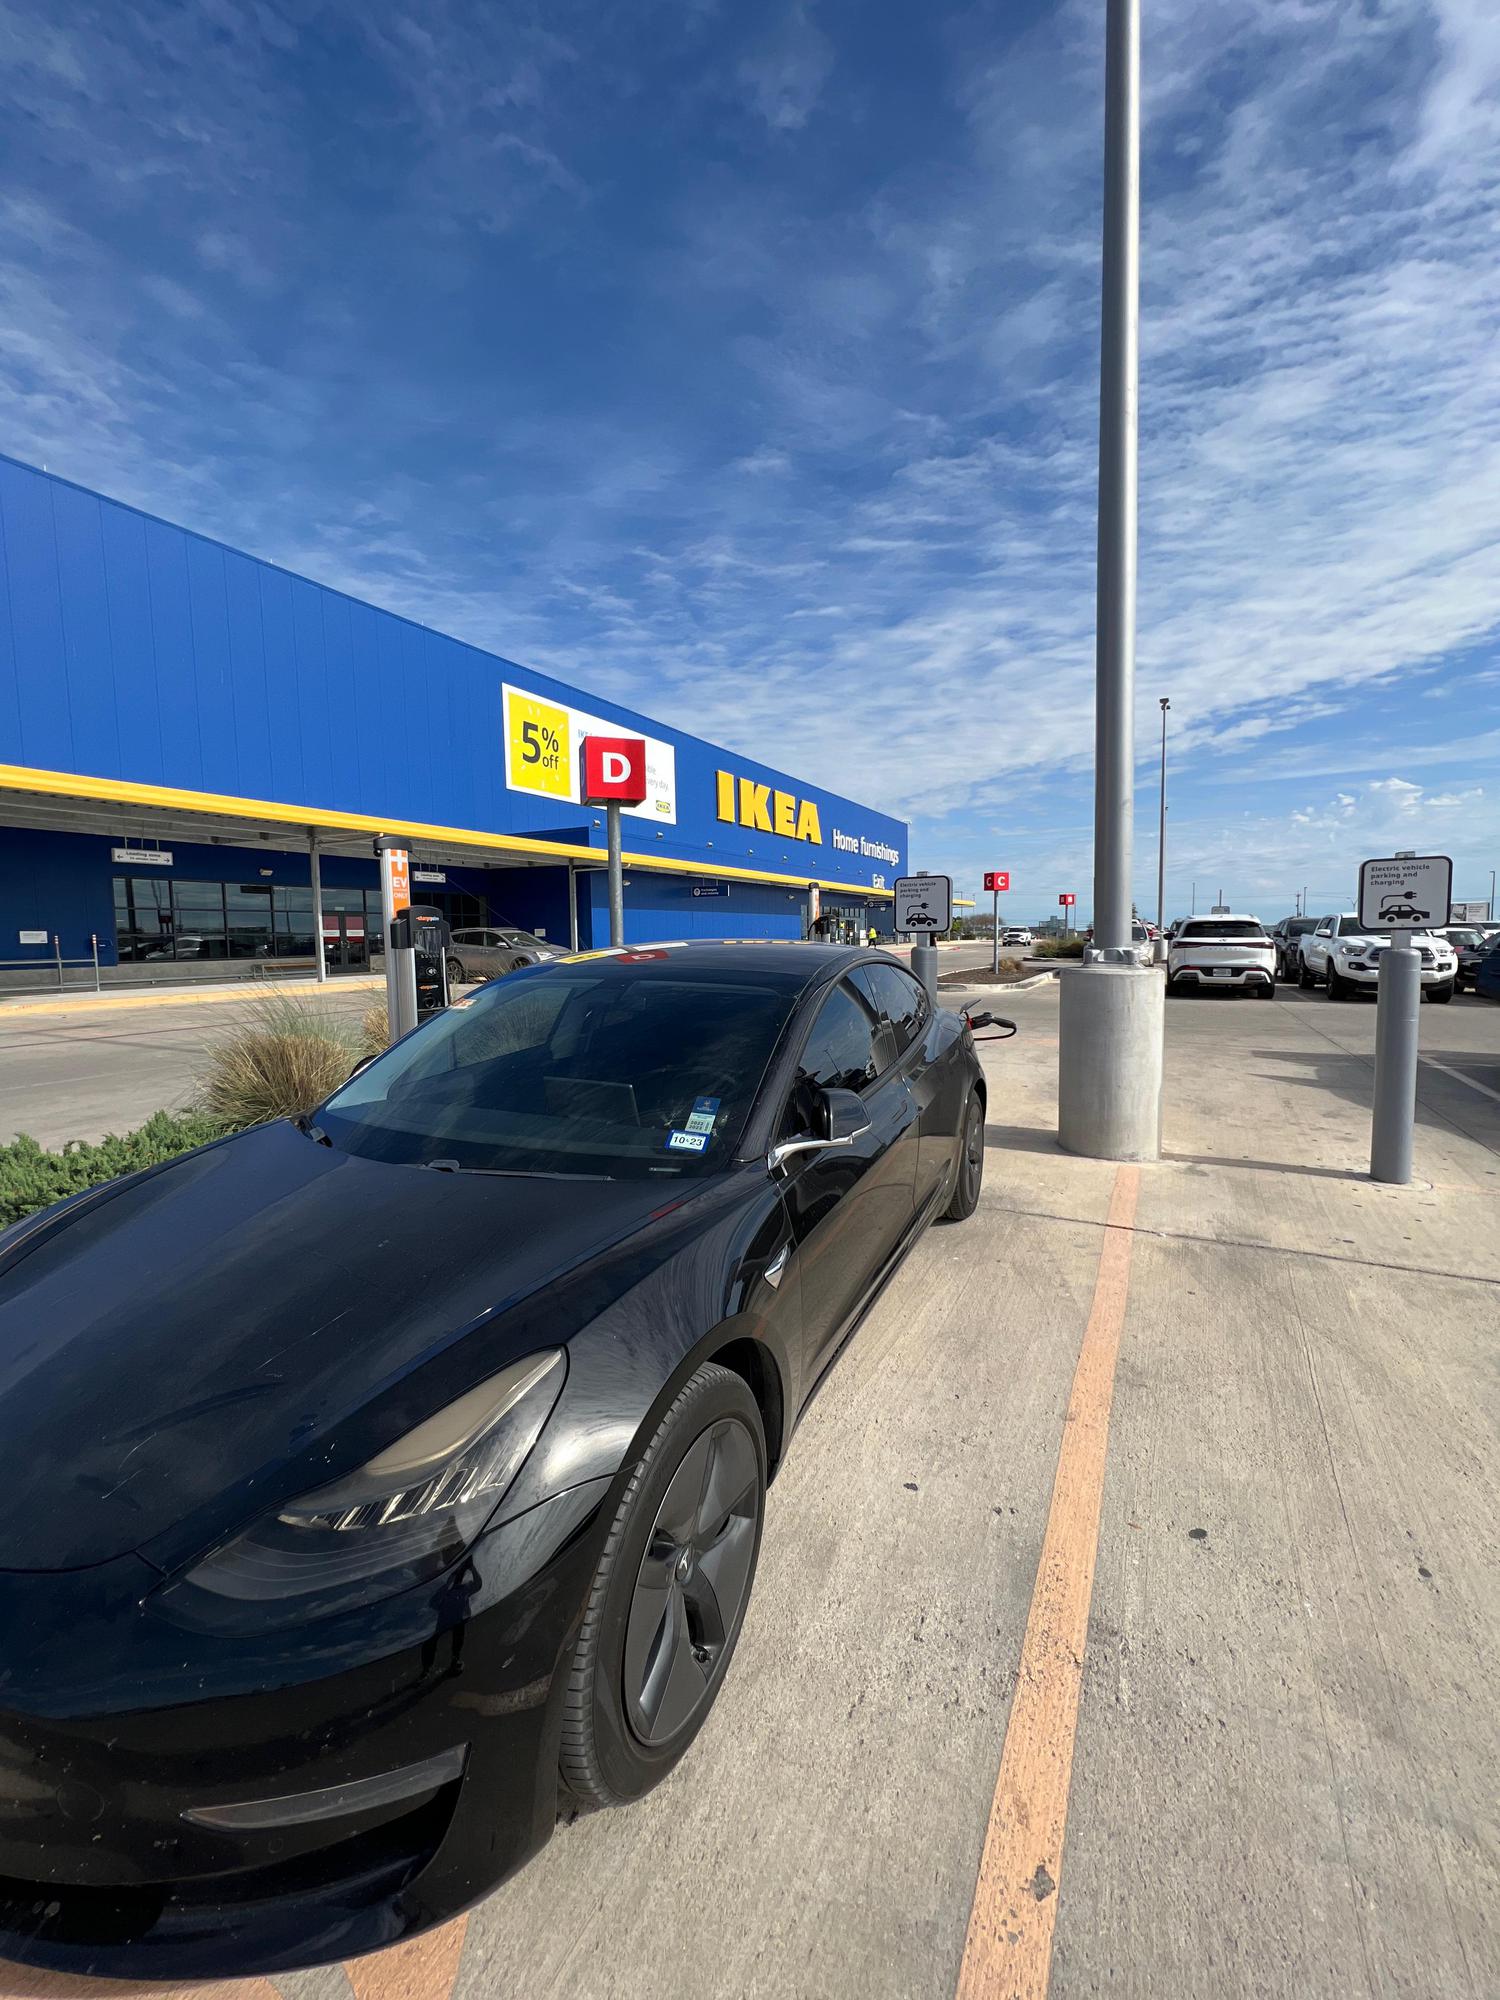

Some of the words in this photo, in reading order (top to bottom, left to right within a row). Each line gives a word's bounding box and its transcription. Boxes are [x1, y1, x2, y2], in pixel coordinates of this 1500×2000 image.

[522, 720, 559, 764] 5%
[542, 755, 559, 770] off
[602, 751, 632, 784] D
[716, 769, 822, 845] IKEA
[832, 828, 859, 854] Home
[860, 836, 899, 867] furnishings
[393, 876, 408, 888] EV
[872, 873, 886, 890] Exit
[997, 875, 1006, 887] C
[1370, 872, 1400, 880] parking
